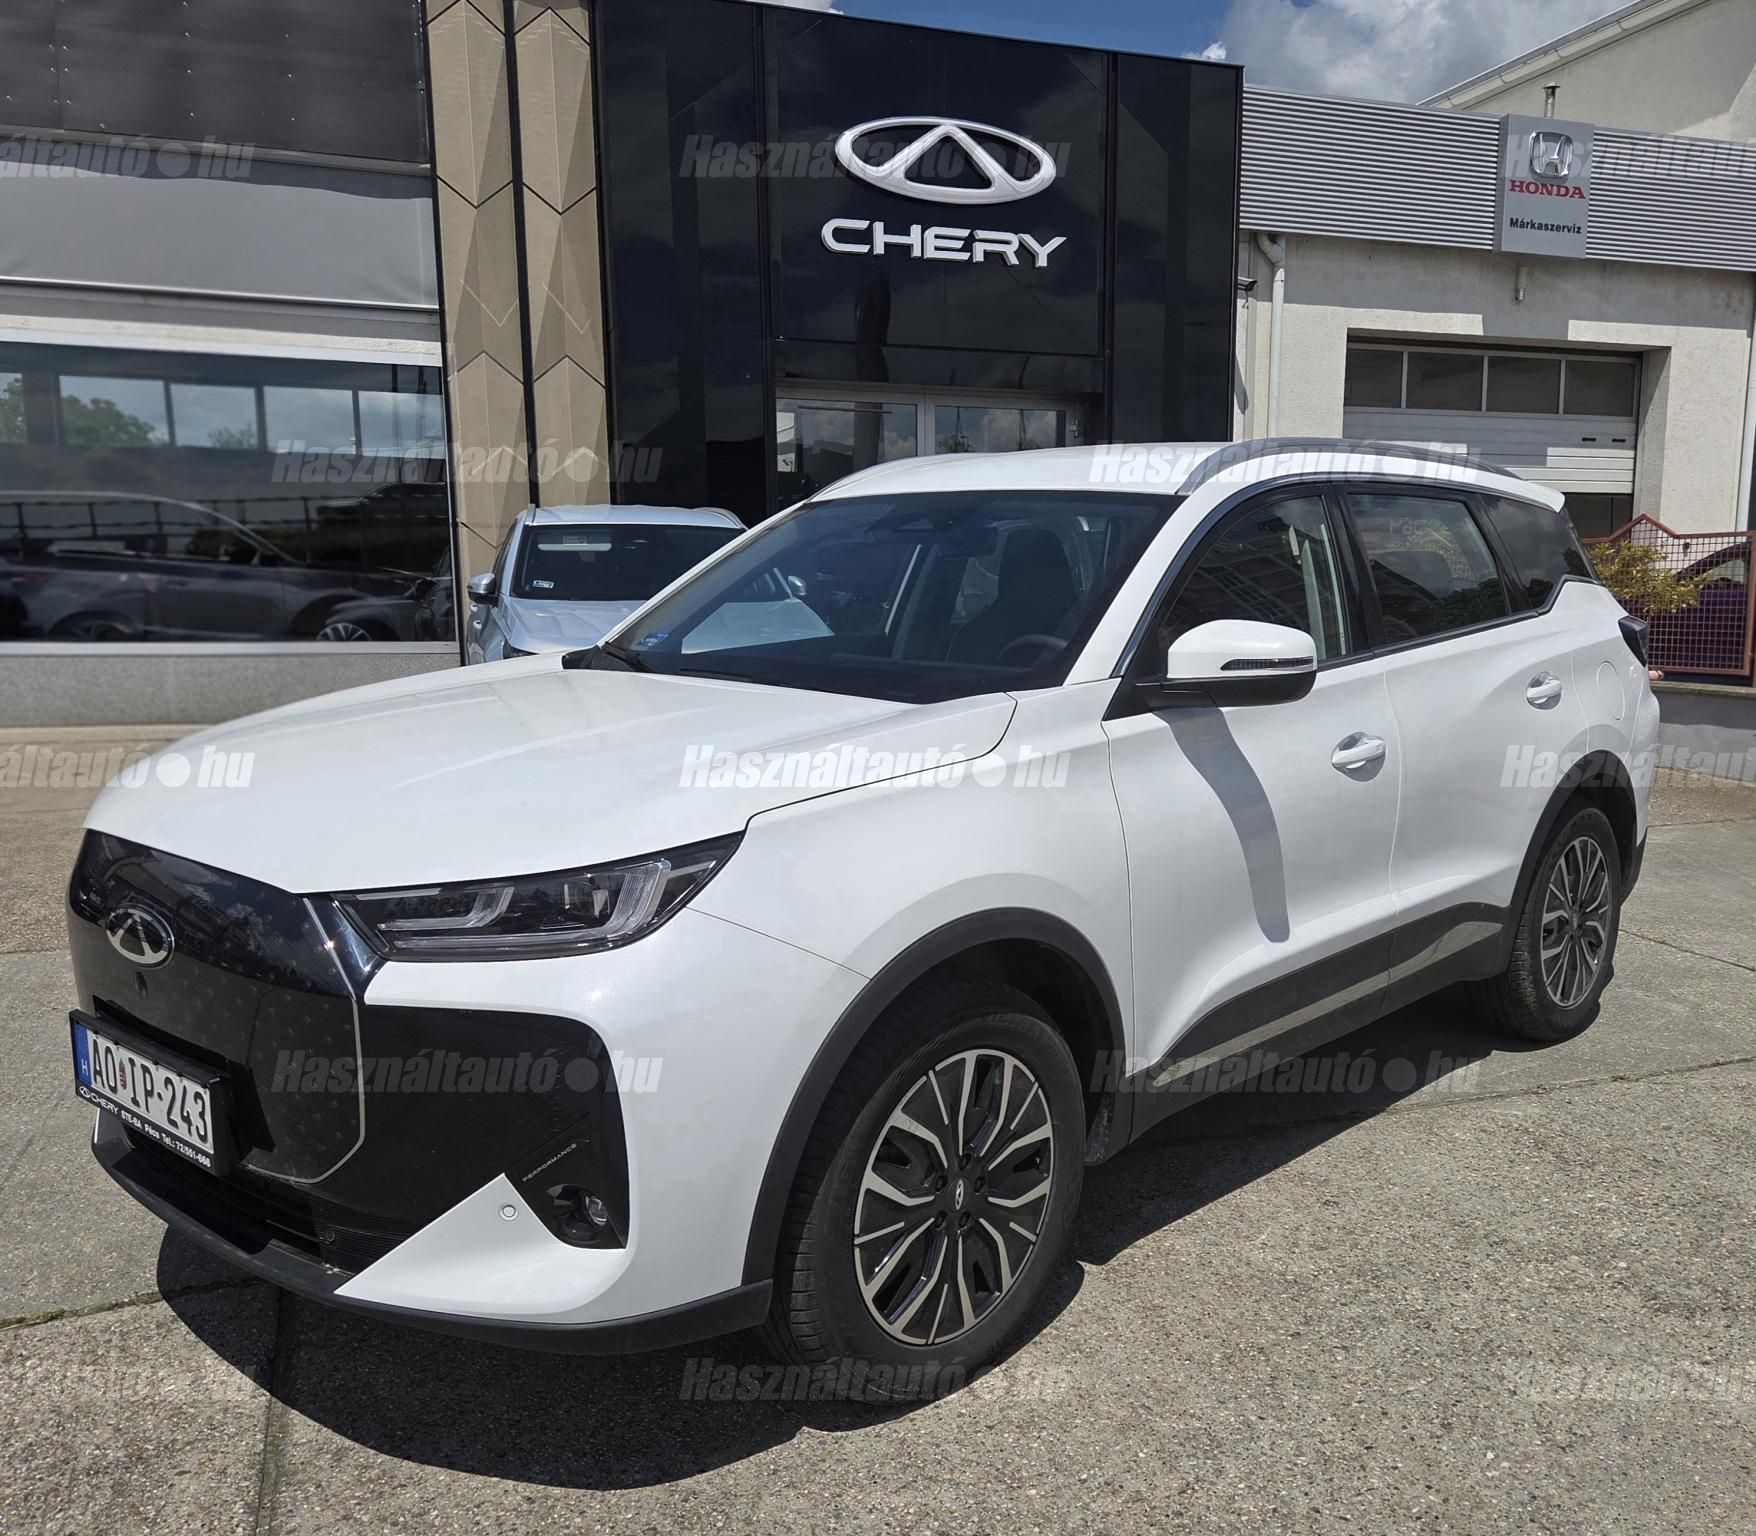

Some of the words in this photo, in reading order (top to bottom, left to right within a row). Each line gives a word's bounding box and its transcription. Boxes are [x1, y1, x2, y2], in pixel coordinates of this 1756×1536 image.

[1509, 179, 1586, 199] HONDA
[1509, 217, 1582, 235] Márkaszerviz
[821, 217, 1067, 268] CHERY
